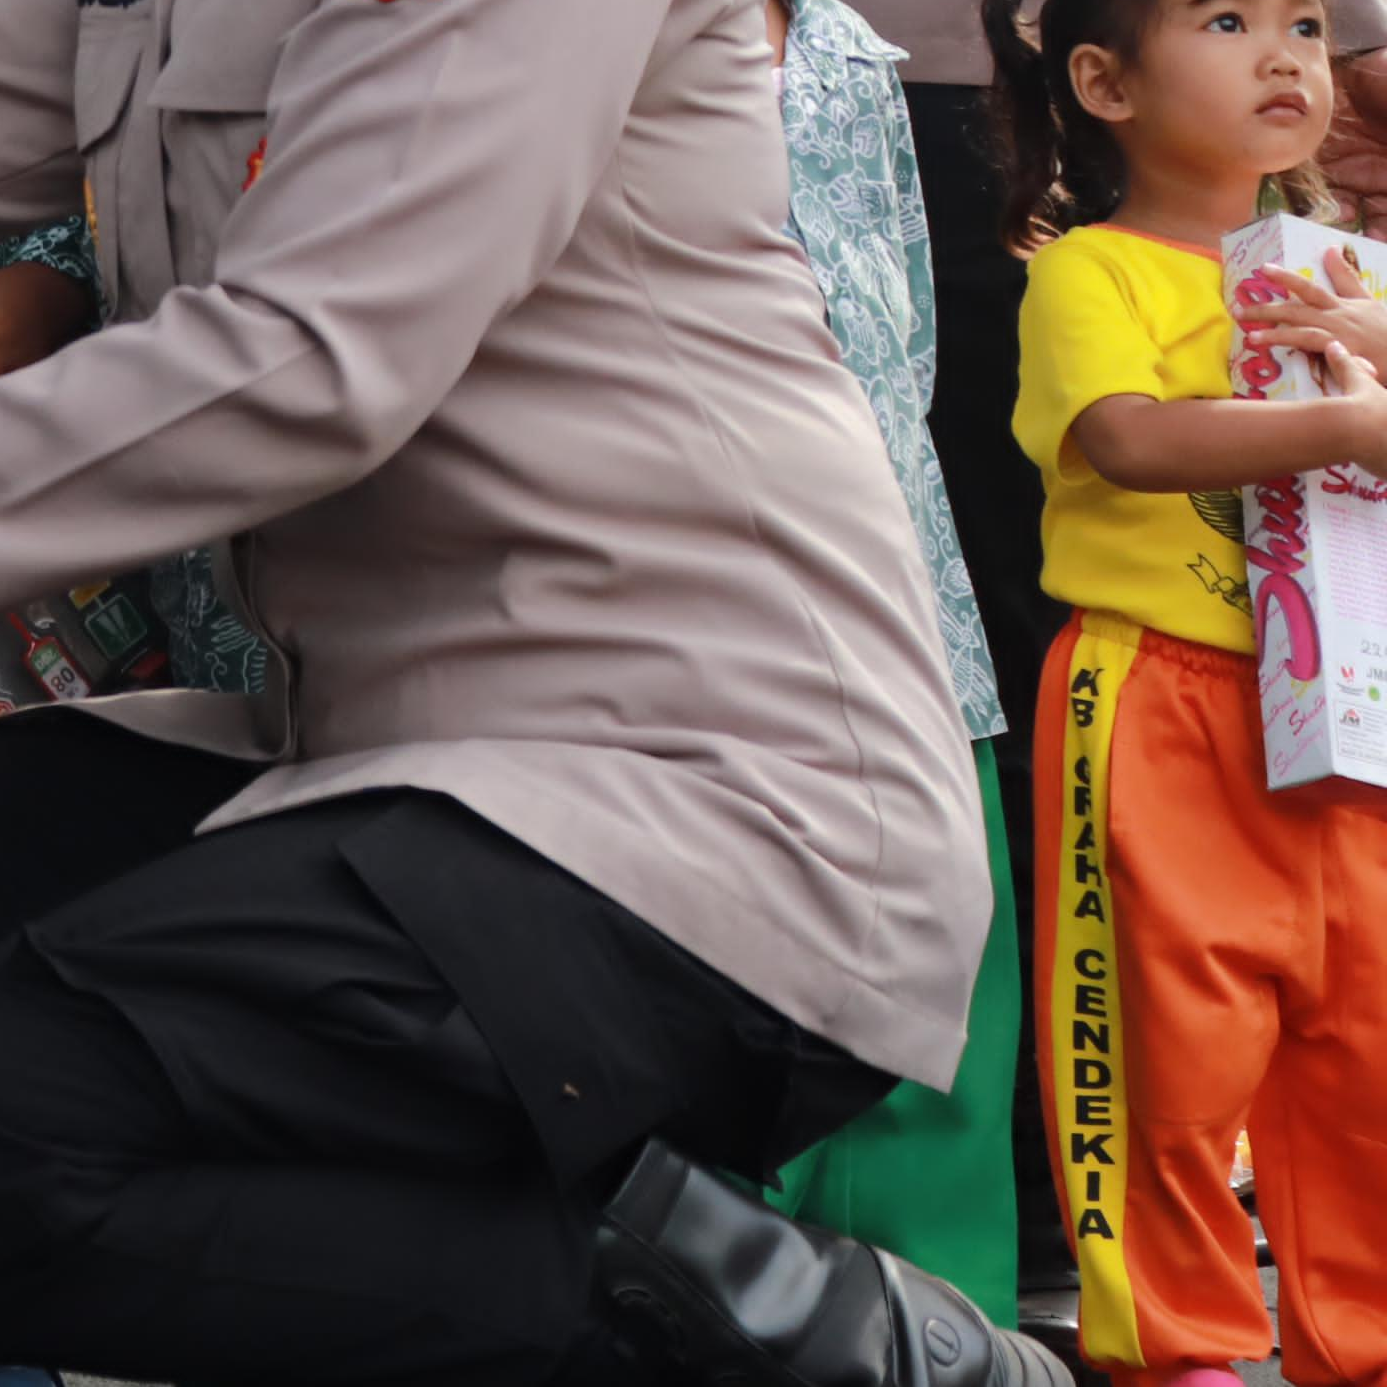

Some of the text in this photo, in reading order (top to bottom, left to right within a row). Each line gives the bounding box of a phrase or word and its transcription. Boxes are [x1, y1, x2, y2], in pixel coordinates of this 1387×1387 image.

[50, 666, 76, 693] 80
[1070, 667, 1106, 728] KB
[1070, 948, 1116, 1240] CENDEKIA
